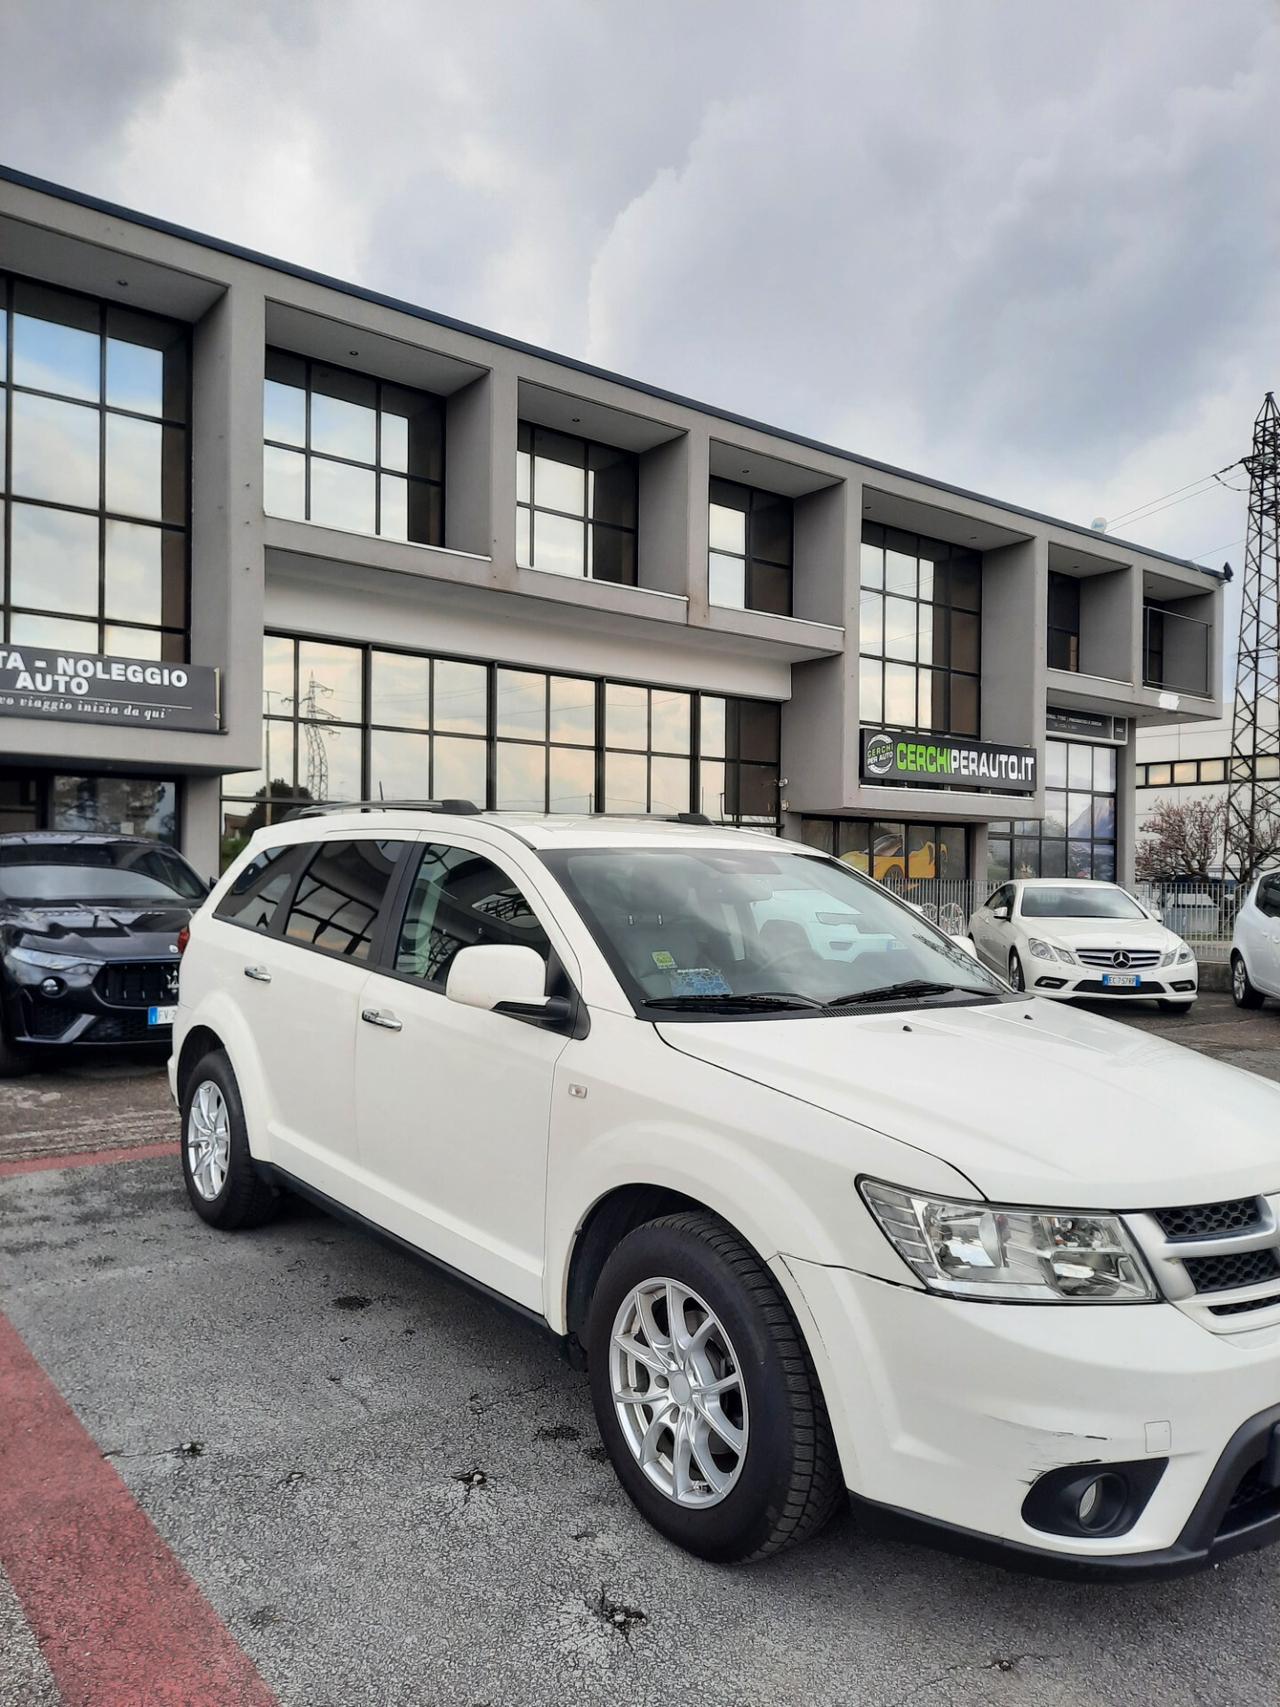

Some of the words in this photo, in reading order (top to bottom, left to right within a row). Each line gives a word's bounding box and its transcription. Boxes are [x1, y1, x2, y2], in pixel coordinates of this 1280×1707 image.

[15, 671, 89, 695] AUTO
[57, 656, 188, 688] NOLEGGIO
[20, 695, 72, 712] viaggio
[78, 700, 119, 715] inizia
[123, 704, 139, 716] da
[867, 743, 894, 758] CERCHI
[867, 756, 878, 765] PER
[896, 742, 1035, 781] CERCHIPERAUTO.IT
